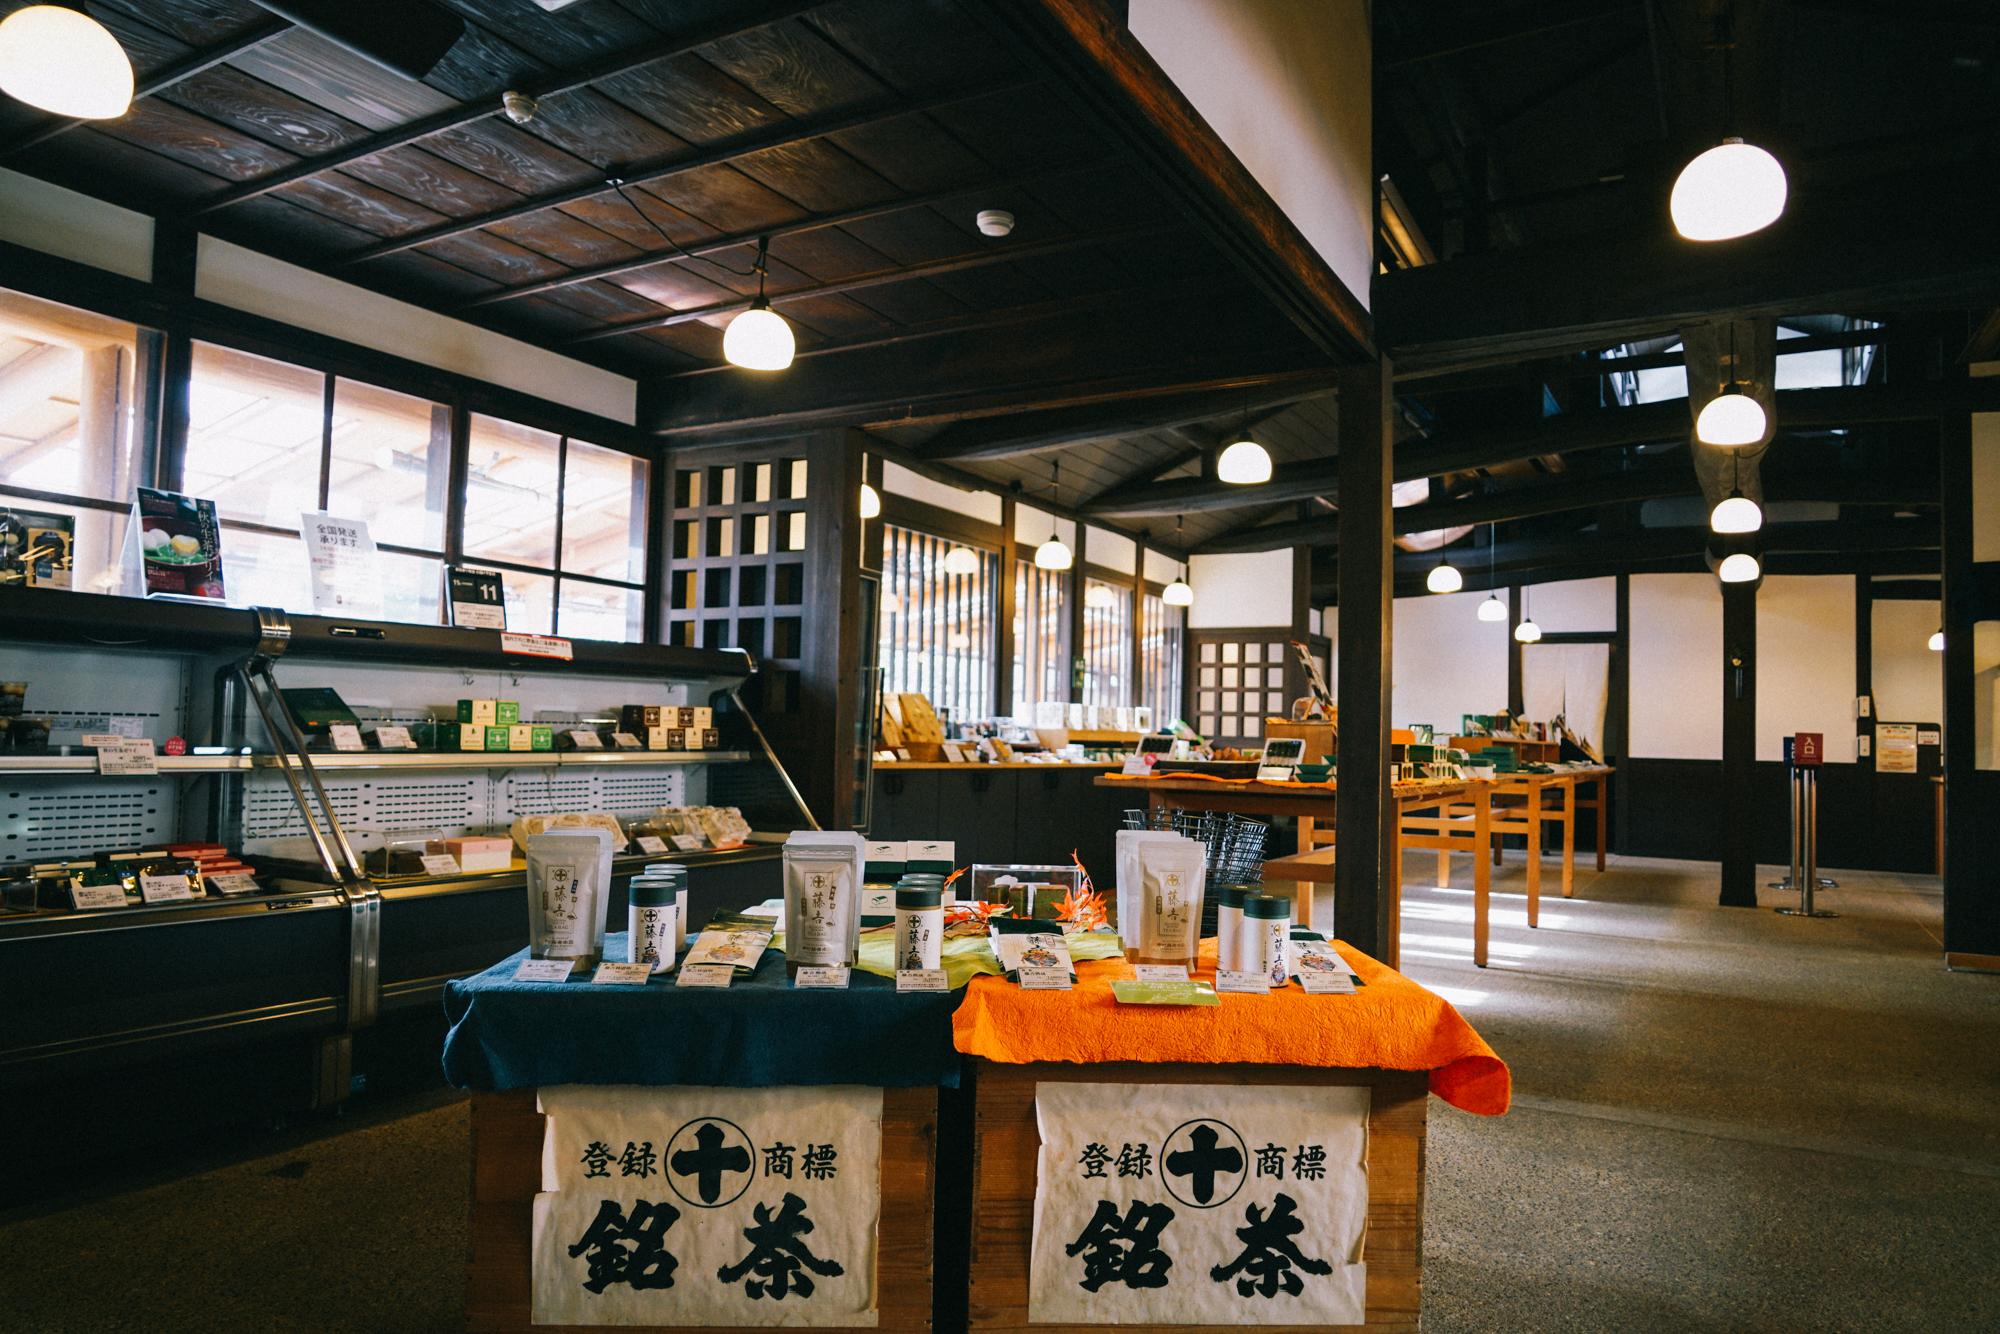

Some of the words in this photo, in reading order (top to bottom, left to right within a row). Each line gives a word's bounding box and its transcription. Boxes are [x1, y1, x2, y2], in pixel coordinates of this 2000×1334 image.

[316, 523, 358, 539] 全国発送
[319, 534, 358, 548] 承ります
[480, 583, 498, 601] 11
[1804, 736, 1815, 755] 入口
[580, 1141, 658, 1179] 登録
[761, 1141, 838, 1181] 商標
[1078, 1142, 1153, 1180] 登録
[1253, 1142, 1327, 1181] 商標
[567, 1191, 845, 1301] 銘茶
[1065, 1192, 1333, 1300] 銘茶
